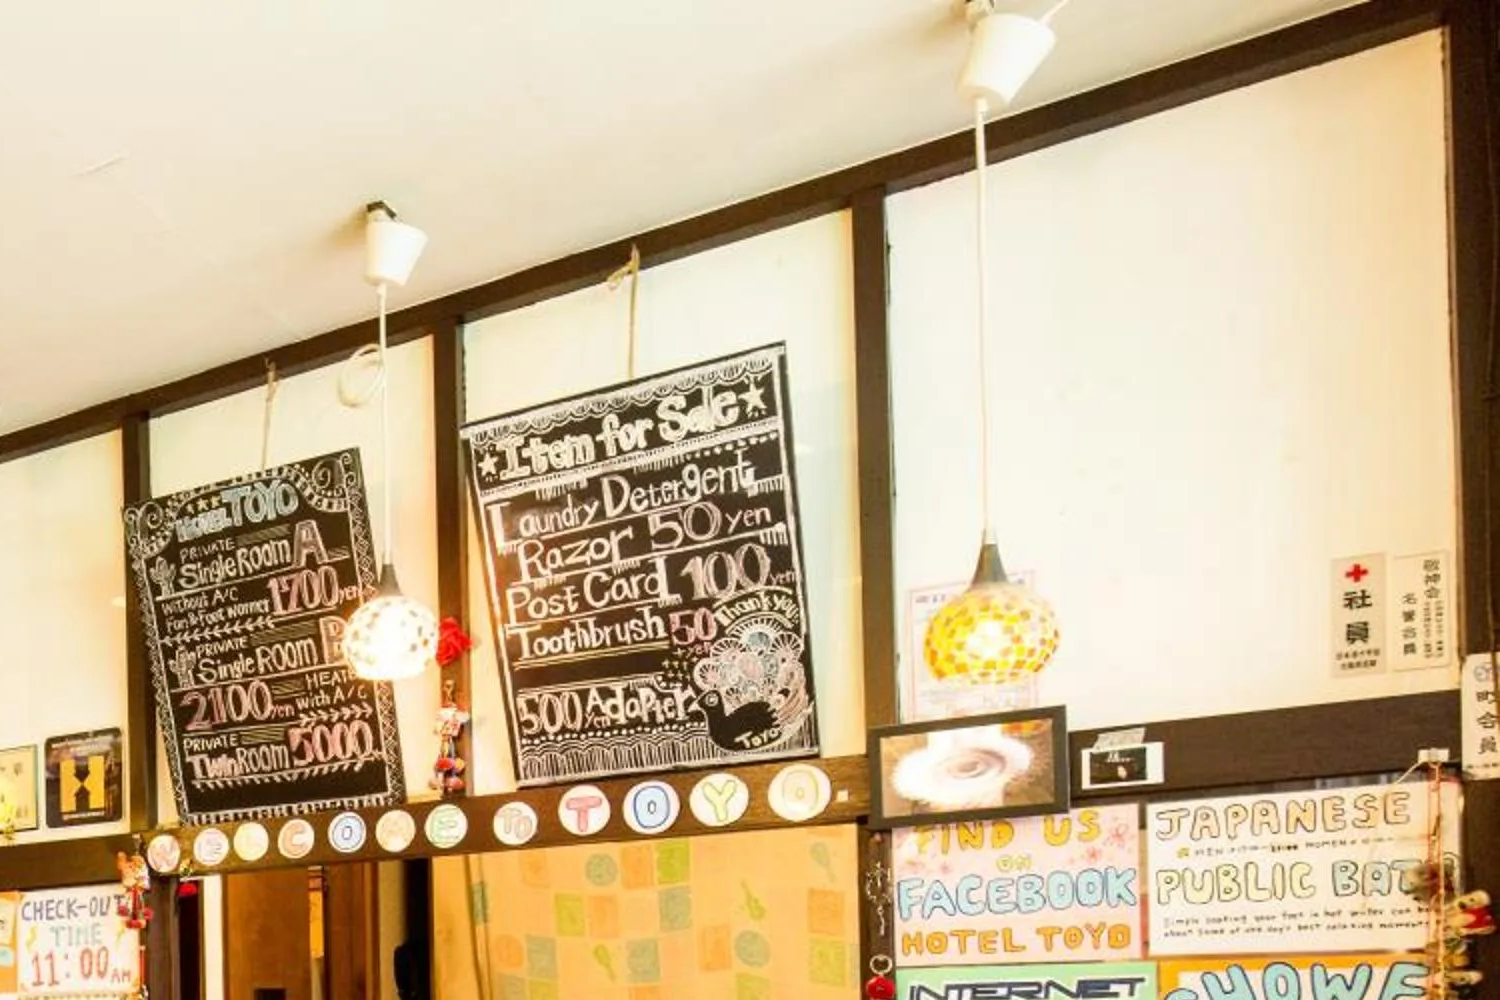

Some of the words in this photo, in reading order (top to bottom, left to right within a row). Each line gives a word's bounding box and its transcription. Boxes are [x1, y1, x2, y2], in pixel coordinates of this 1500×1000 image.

[499, 434, 596, 480] Item
[596, 412, 654, 457] for
[656, 384, 740, 442] Sale
[486, 501, 598, 555] Laundry
[600, 450, 757, 518] Detergent
[180, 538, 236, 564] PRIVATE
[293, 519, 328, 568] A
[518, 525, 633, 582] Razor
[648, 501, 724, 550] 50
[726, 505, 772, 533] yen
[266, 565, 340, 616] 1700
[507, 586, 580, 627] Post
[583, 555, 681, 608] Card
[680, 542, 772, 602] 100
[505, 606, 669, 661] Toothbrush
[668, 606, 719, 646] 50
[1343, 589, 1372, 645] 社員
[180, 678, 273, 731] 2100
[517, 690, 582, 736] 500
[183, 733, 239, 752] PRIVATE
[287, 719, 375, 768] 5000
[1043, 809, 1101, 847] US
[1156, 791, 1412, 841] JAPANESE
[897, 865, 1138, 921] FACEBOOK
[1156, 862, 1316, 905] PUBLIC
[1332, 853, 1461, 897] BAT
[49, 922, 103, 948] TIME
[901, 927, 1027, 957] HOTEL
[1036, 921, 1132, 953] TOYO
[32, 946, 110, 987] 11:00
